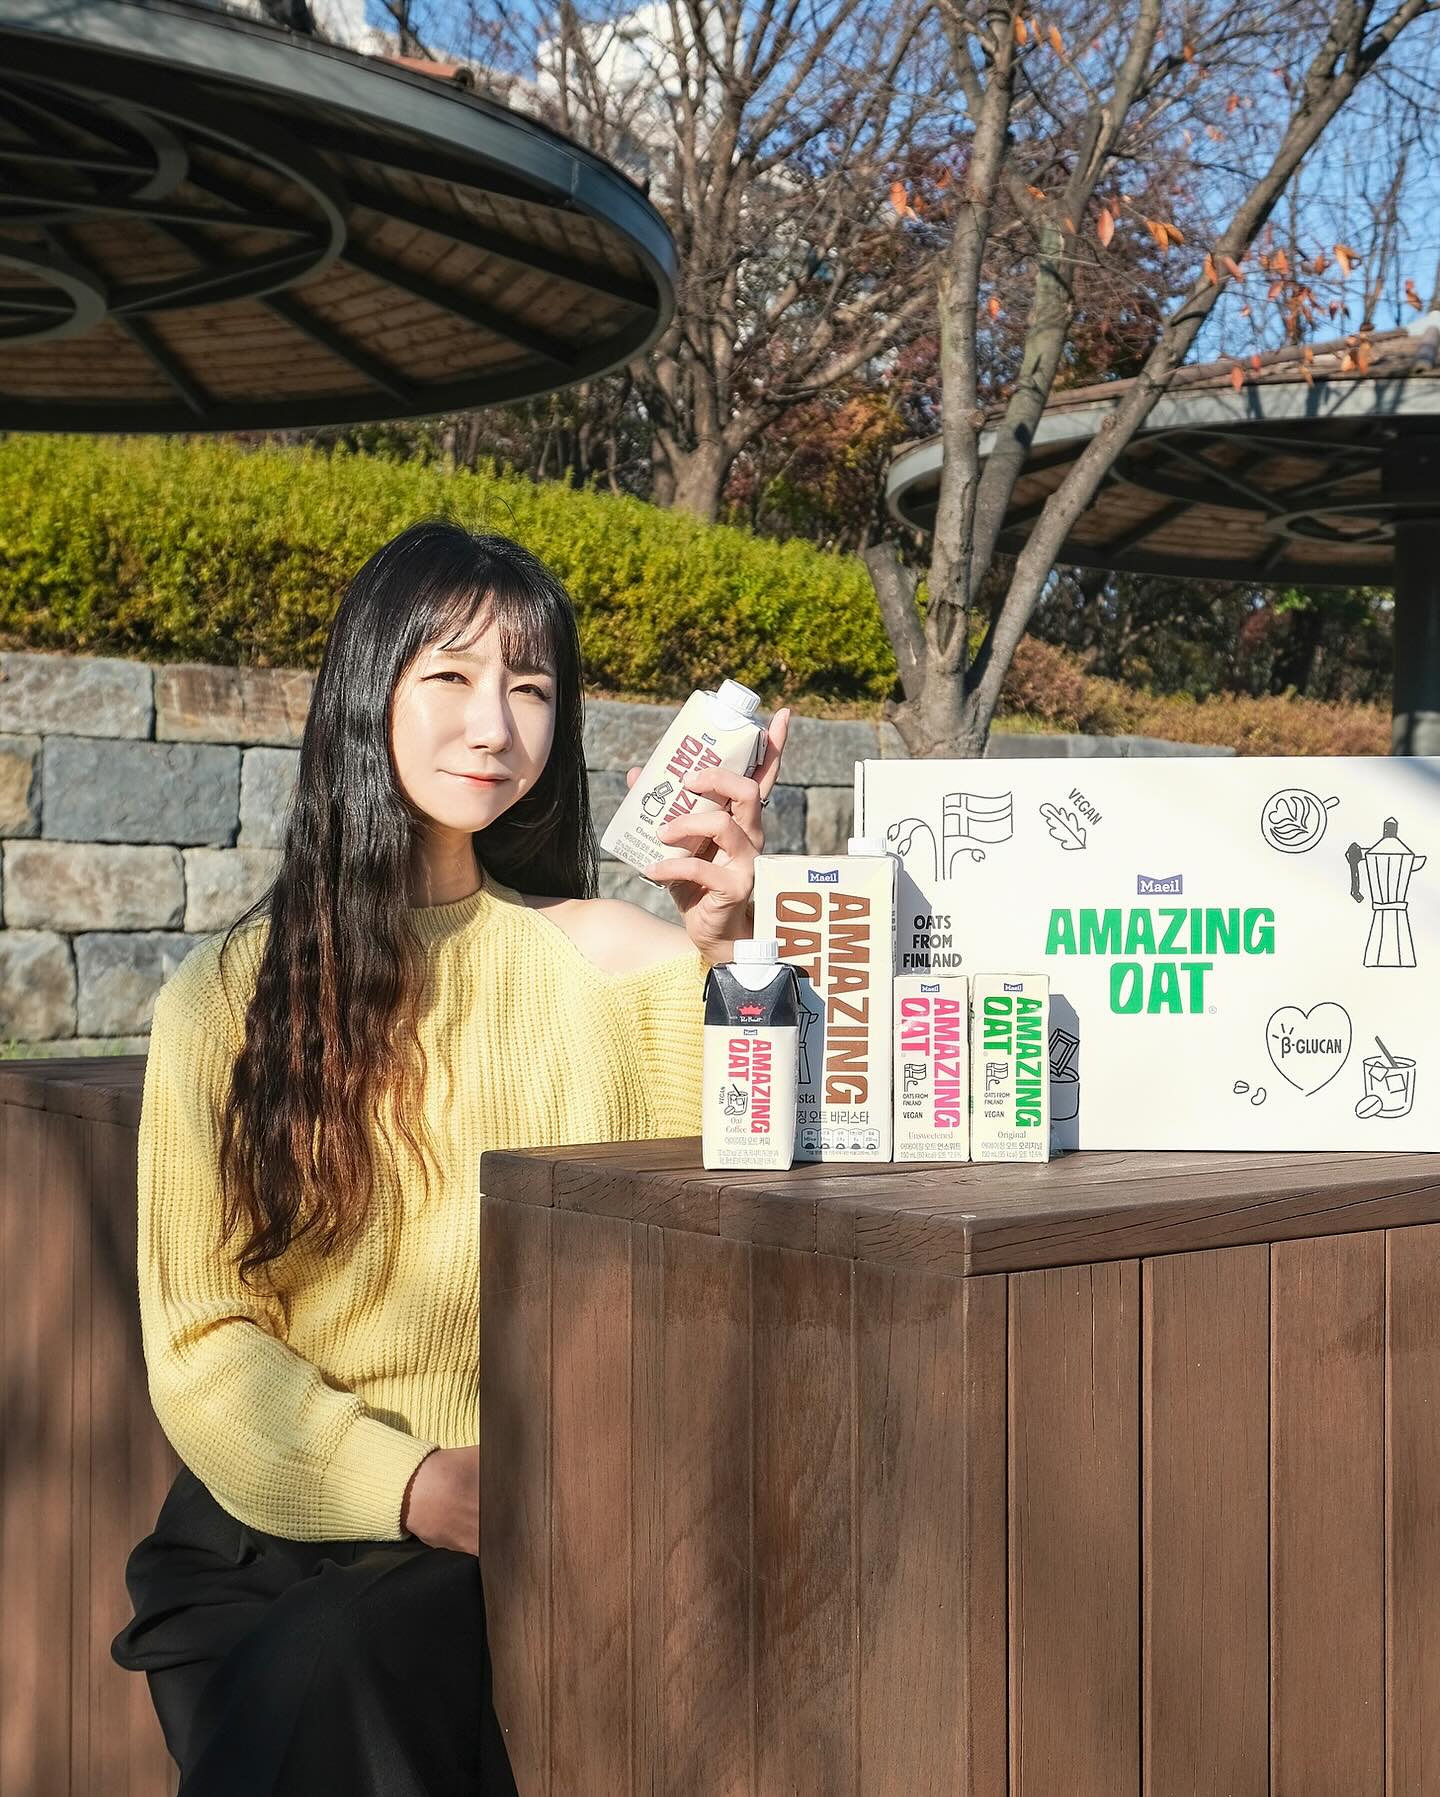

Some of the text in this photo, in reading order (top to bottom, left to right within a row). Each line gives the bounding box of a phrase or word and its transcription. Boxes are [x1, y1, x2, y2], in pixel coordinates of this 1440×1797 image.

[666, 734, 703, 783] OAT
[1068, 787, 1103, 826] VEGAN
[809, 872, 839, 882] Maeil
[1139, 878, 1181, 893] Maeil
[775, 891, 822, 987] OAT
[912, 933, 953, 949] FROM
[913, 914, 952, 930] OATS
[1045, 907, 1275, 955] AMAZING
[902, 952, 963, 968] FINLAND
[825, 891, 870, 1105] AMAZING
[1110, 962, 1213, 1014] OAT
[901, 997, 930, 1056] OAT
[983, 996, 1012, 1055] OAT
[728, 1038, 750, 1081] OAT
[934, 997, 961, 1128] AMAZING
[1015, 996, 1042, 1127] AMAZING
[751, 1039, 772, 1133] AMAZING
[725, 1125, 748, 1134] Coffee
[809, 1110, 828, 1123] 오트
[830, 1110, 870, 1125] 바리스타
[902, 1111, 923, 1119] VEGAN
[984, 1110, 1005, 1118] VEGAN
[997, 1130, 1027, 1140] Original
